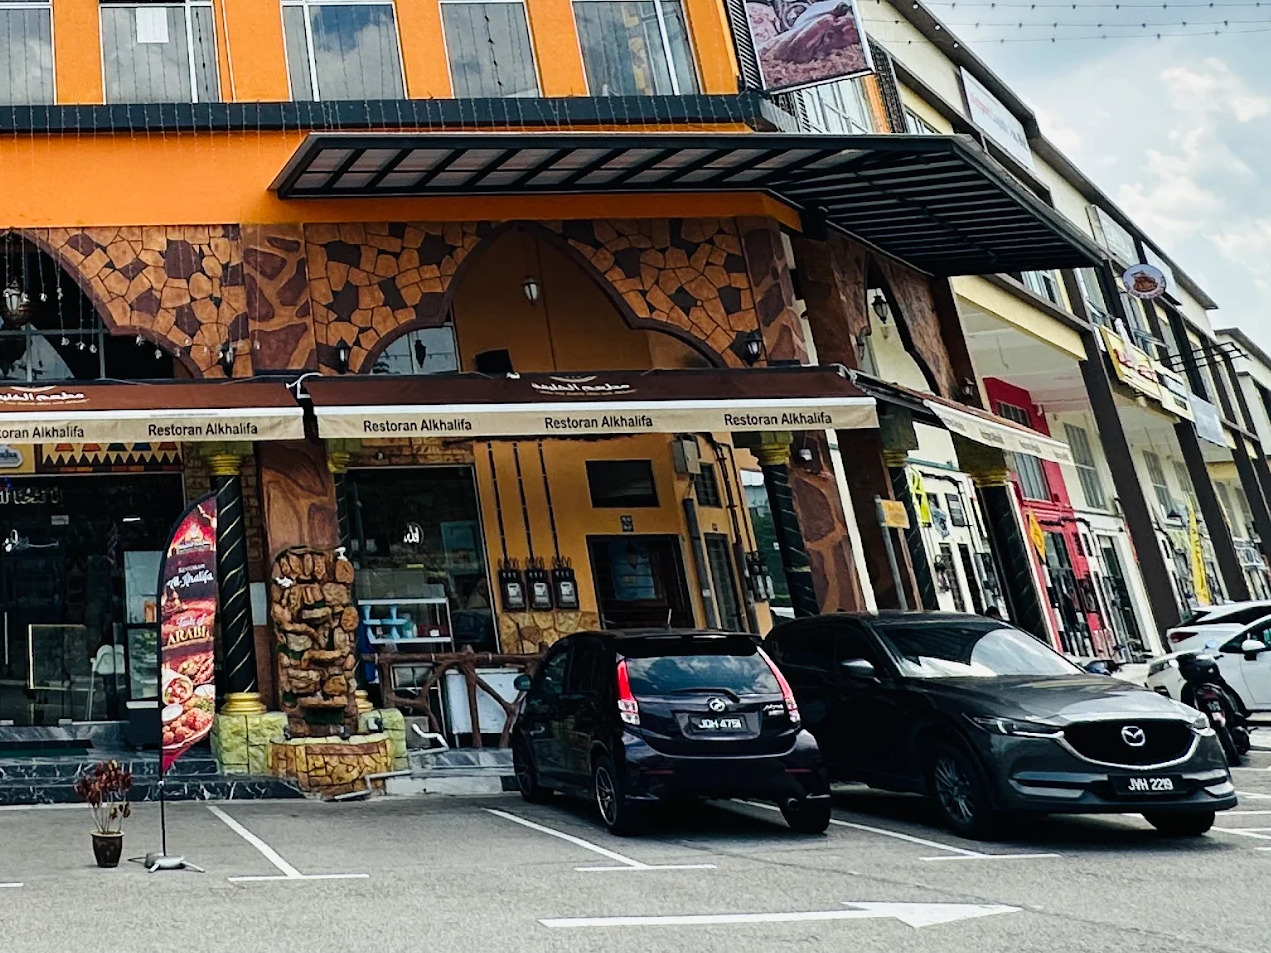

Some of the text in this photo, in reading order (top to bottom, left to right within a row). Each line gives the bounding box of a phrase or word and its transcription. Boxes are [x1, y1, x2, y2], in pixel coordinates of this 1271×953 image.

[364, 418, 472, 432] Restoran Alkhalifa
[545, 415, 653, 429] Restoran Alkhalifa
[724, 412, 832, 426] Restoran Alkhalifa
[32, 426, 84, 438] Alkhalifa
[148, 422, 258, 436] Restoran Alkhalifa
